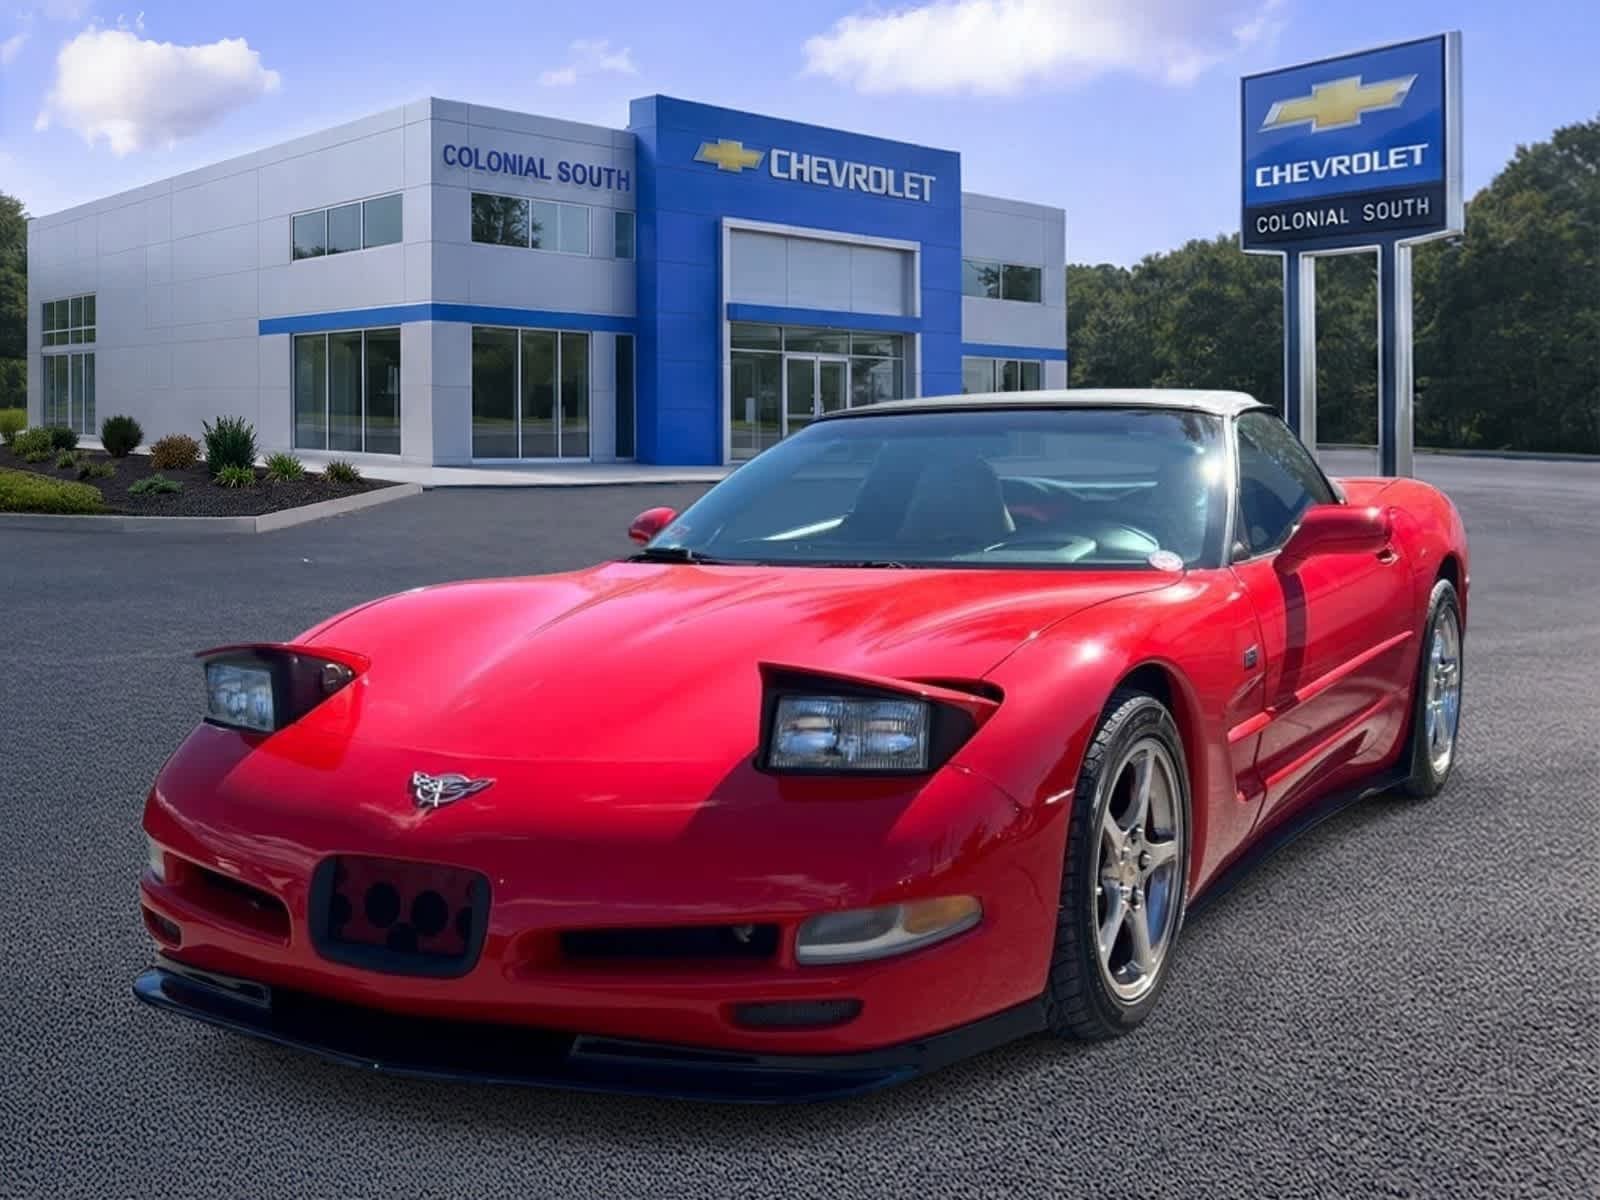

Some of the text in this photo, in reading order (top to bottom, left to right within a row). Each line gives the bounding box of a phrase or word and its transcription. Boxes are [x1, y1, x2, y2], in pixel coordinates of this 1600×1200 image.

[442, 144, 630, 191] COLONIAL SOUTH
[769, 149, 936, 202] CHEVROLET
[1255, 143, 1428, 187] CHEVROLET
[1256, 197, 1430, 233] COLONIAL SOUTH
